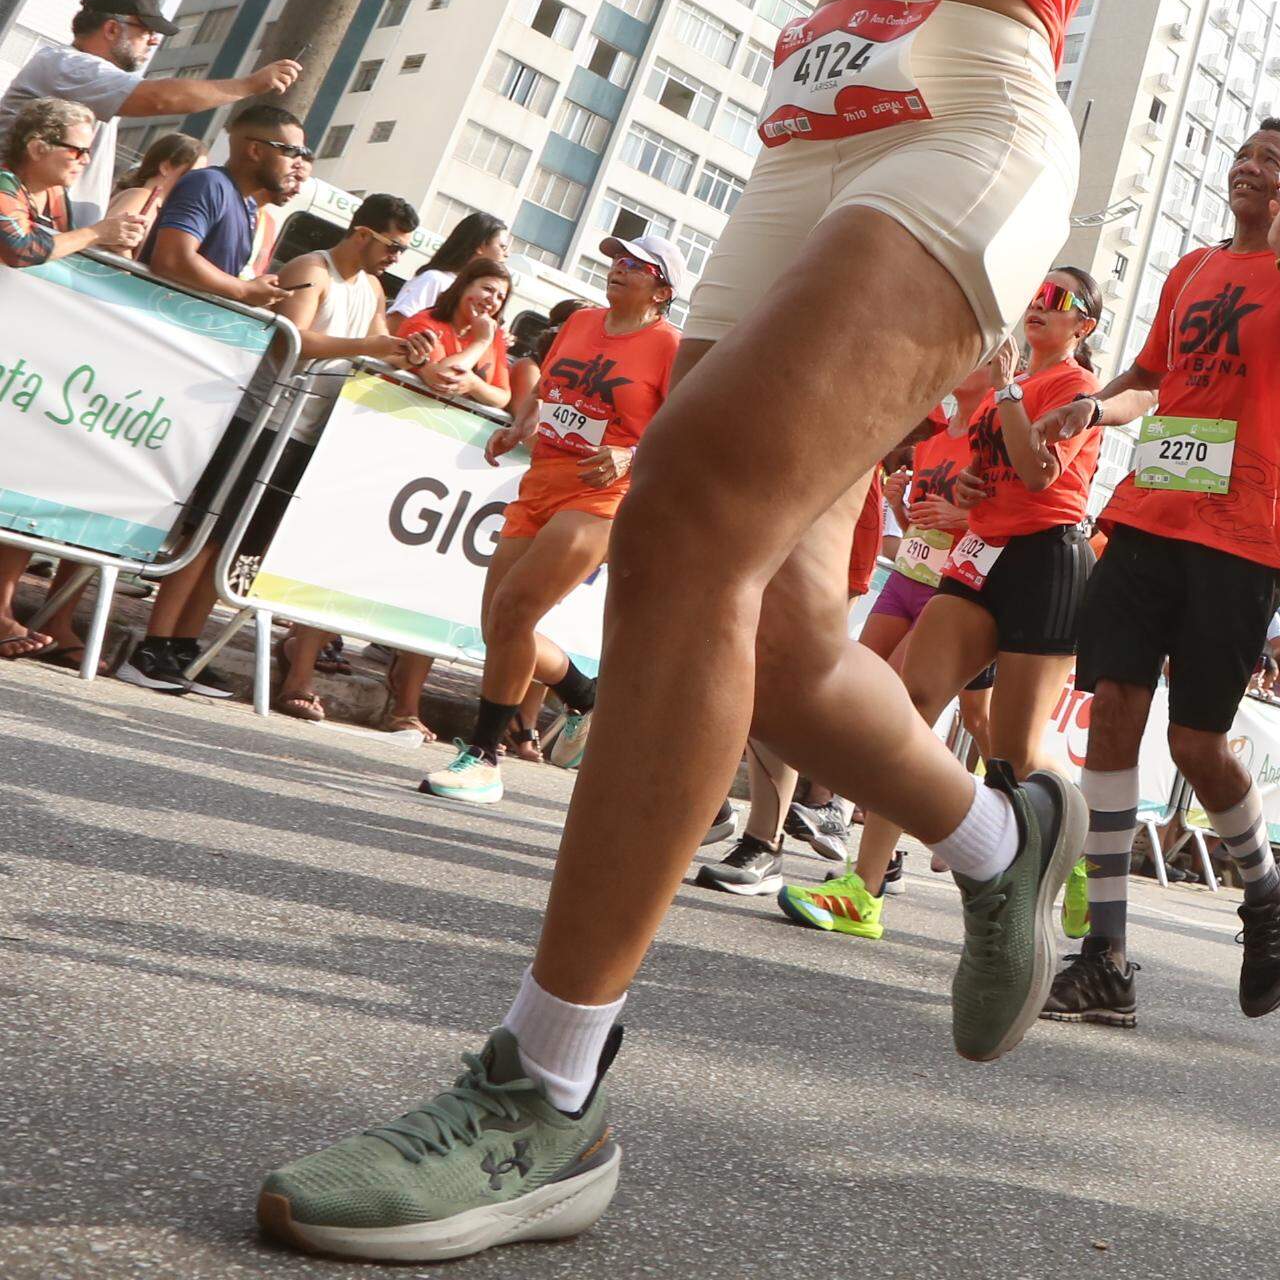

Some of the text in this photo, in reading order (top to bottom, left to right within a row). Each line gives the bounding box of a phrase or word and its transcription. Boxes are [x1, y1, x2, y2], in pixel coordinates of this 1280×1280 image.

[793, 41, 874, 86] 4724
[843, 99, 904, 123] 7h10 GERAL
[44, 364, 172, 450] Saúde
[552, 406, 587, 430] 4079
[1159, 440, 1208, 462] 2270
[907, 539, 930, 560] 2910
